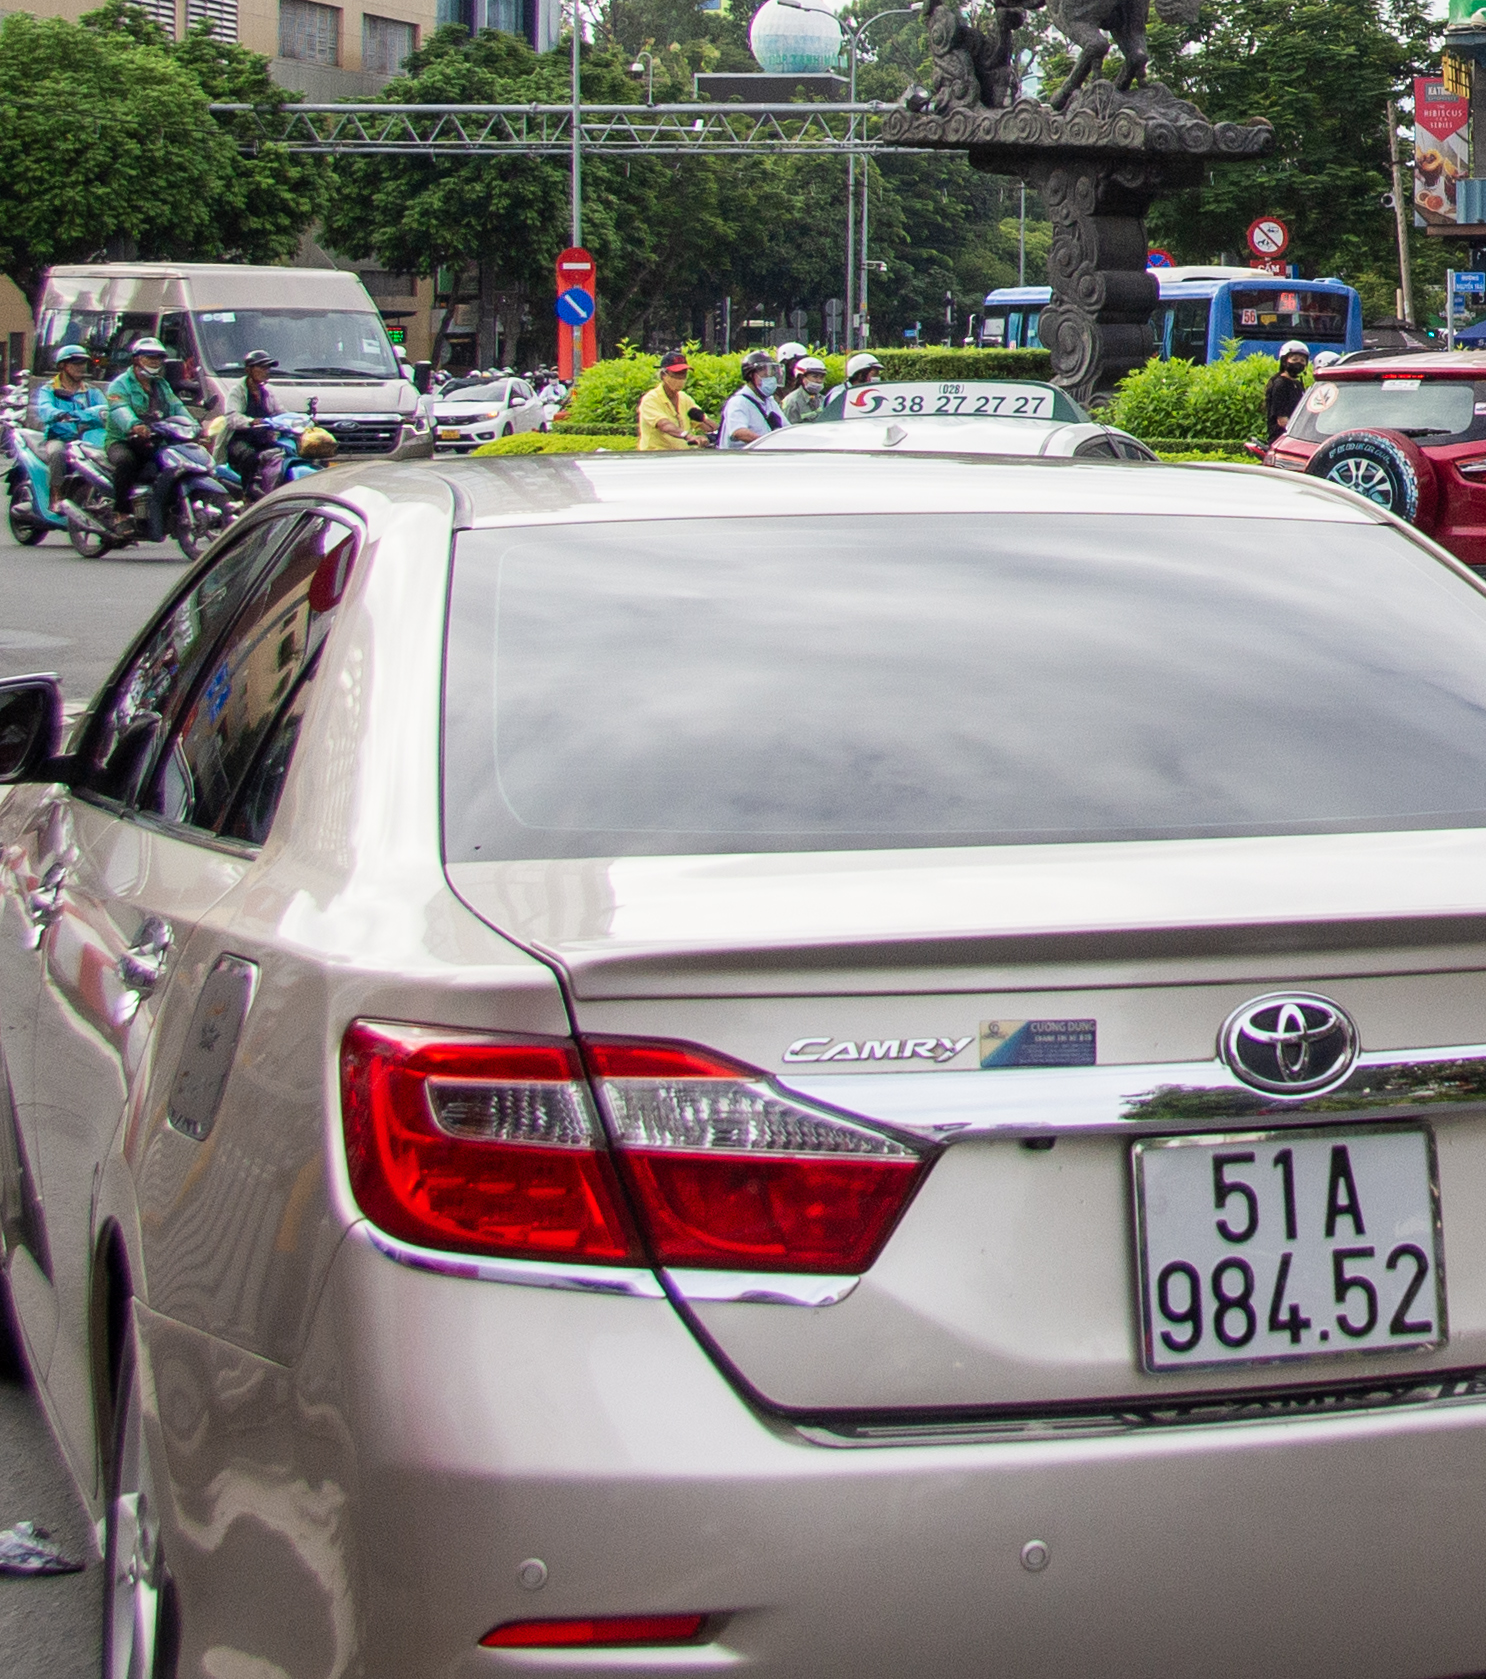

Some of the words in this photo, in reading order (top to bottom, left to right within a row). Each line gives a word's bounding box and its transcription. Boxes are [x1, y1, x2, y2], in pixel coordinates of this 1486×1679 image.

[1423, 109, 1463, 117] HIBISCUS
[1430, 121, 1453, 129] SERIES
[1243, 310, 1256, 323] 56
[891, 395, 924, 413] 38
[936, 396, 970, 414] 27
[975, 396, 1006, 415] 27
[1013, 396, 1047, 415] 27
[782, 1036, 976, 1064] CAMRY
[1210, 1142, 1369, 1246] 51A
[1154, 1241, 1433, 1355] 984.52
